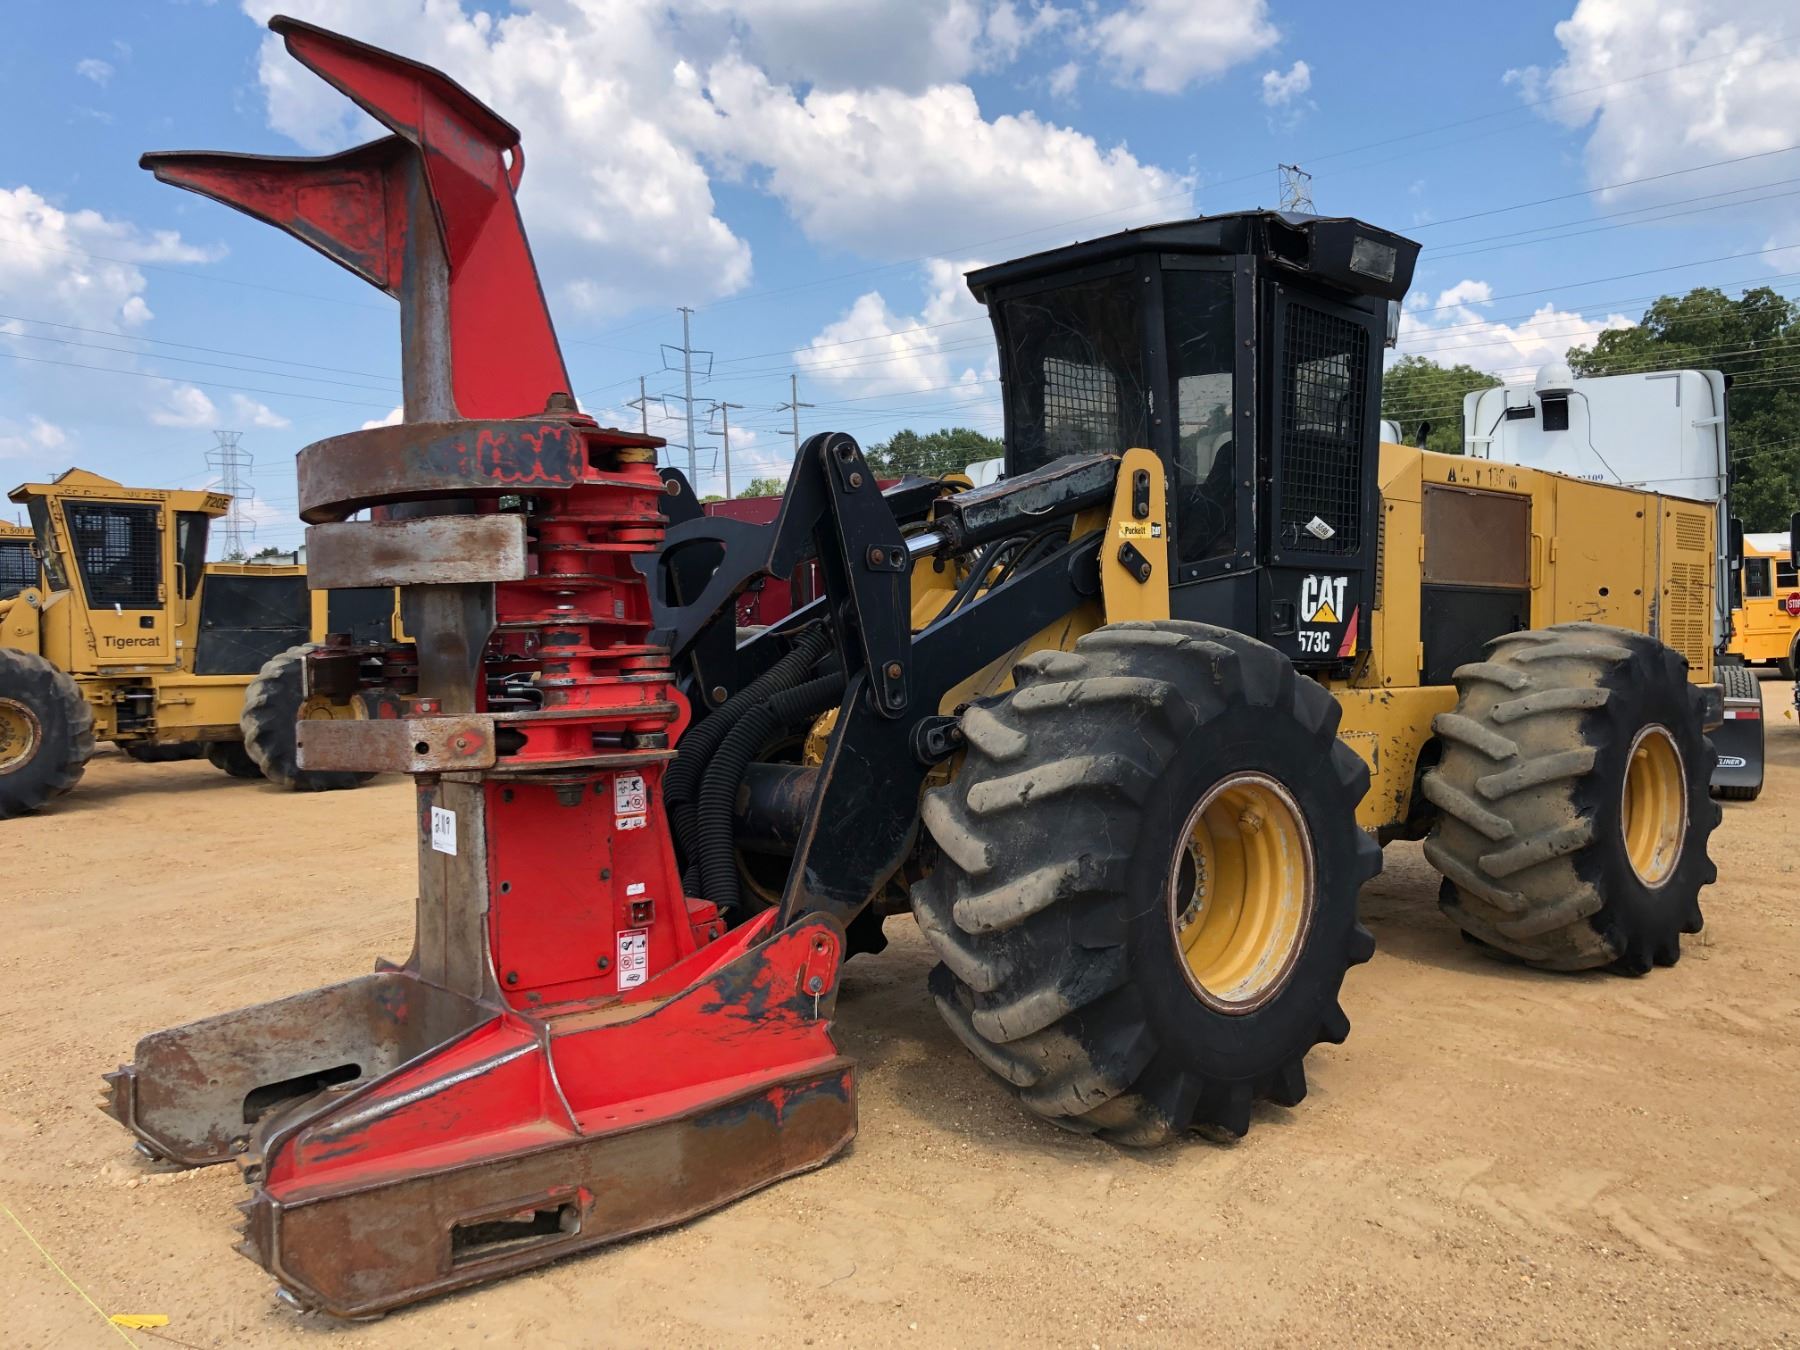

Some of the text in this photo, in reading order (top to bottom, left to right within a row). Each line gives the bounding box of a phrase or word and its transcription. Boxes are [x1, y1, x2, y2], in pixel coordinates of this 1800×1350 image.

[206, 495, 229, 510] 720E
[10, 527, 25, 535] 500
[1301, 573, 1348, 624] CAT
[102, 635, 160, 650] Tigercat
[1298, 630, 1331, 653] 573C
